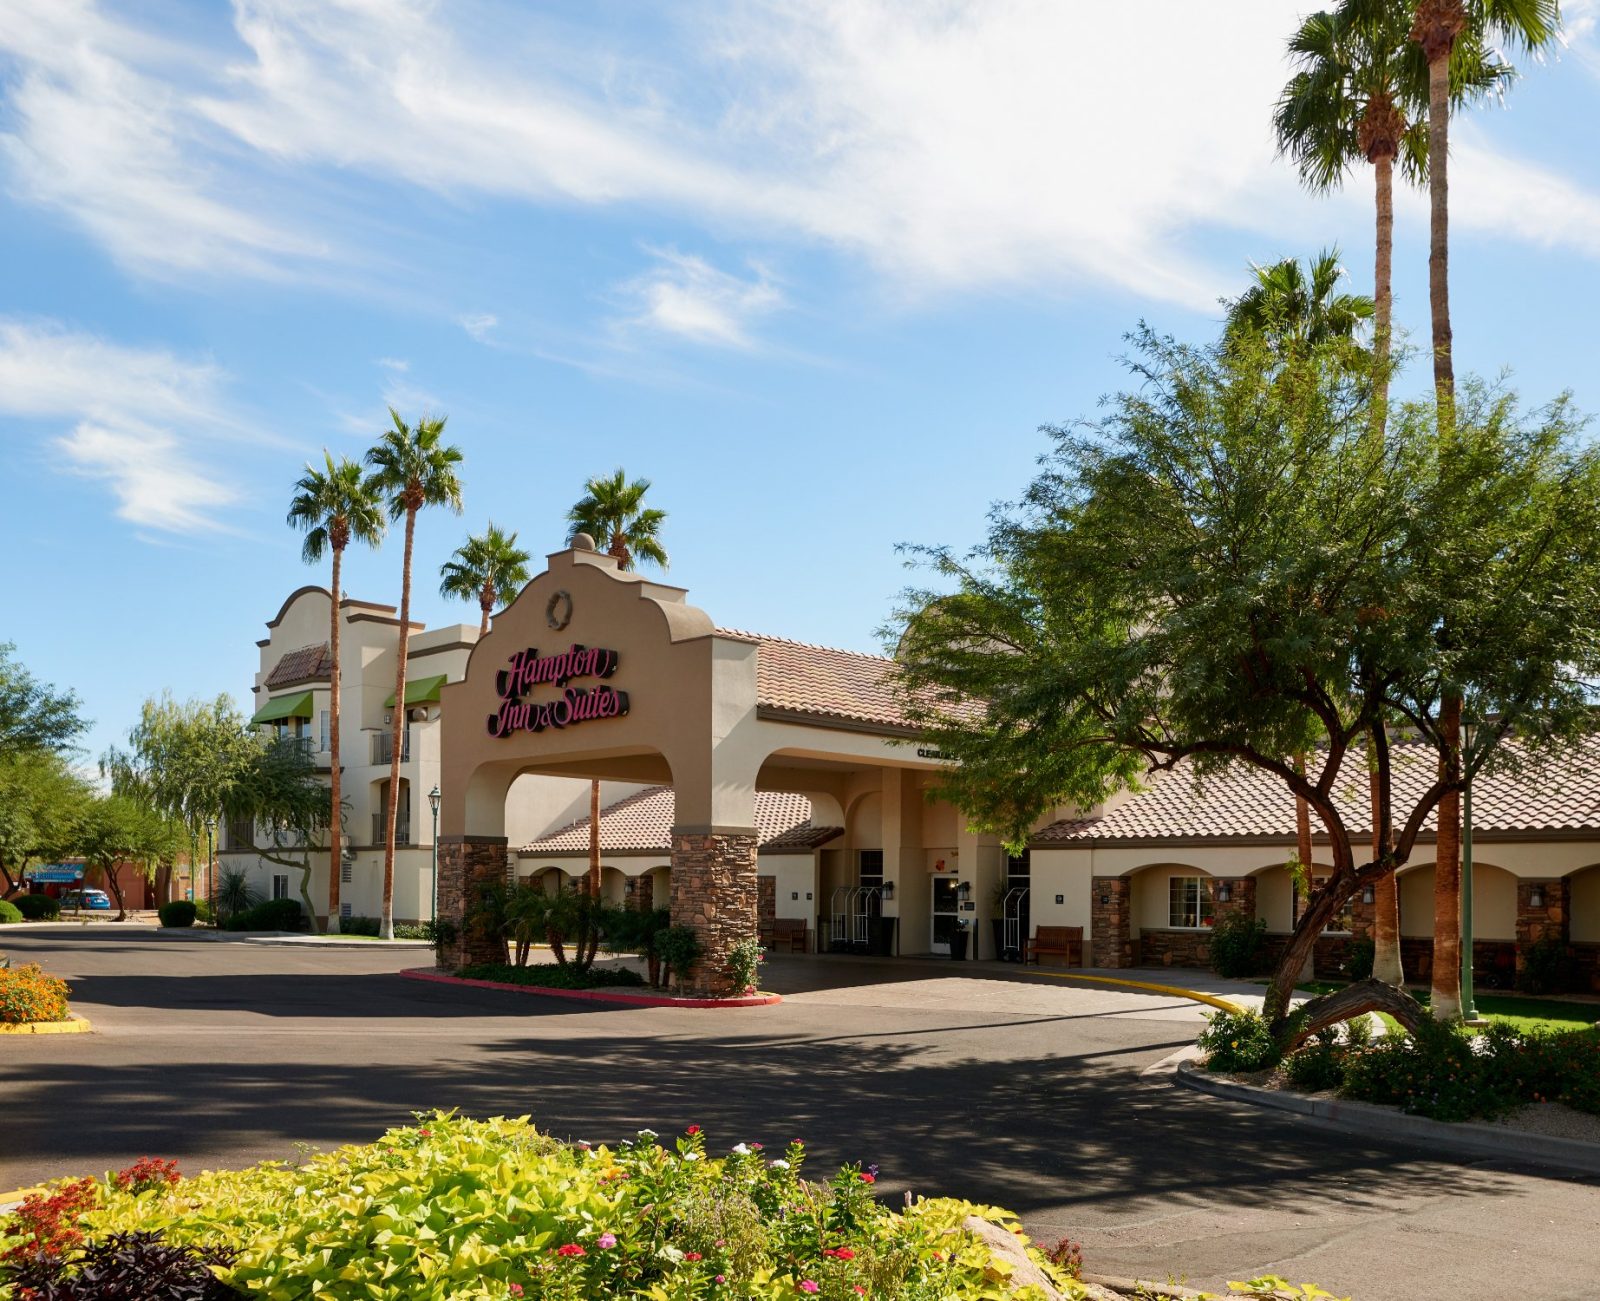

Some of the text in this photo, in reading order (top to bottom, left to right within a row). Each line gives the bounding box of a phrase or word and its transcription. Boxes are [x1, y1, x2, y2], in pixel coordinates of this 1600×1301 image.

[495, 643, 611, 699] Hampton
[487, 685, 622, 739] Inn & Suites
